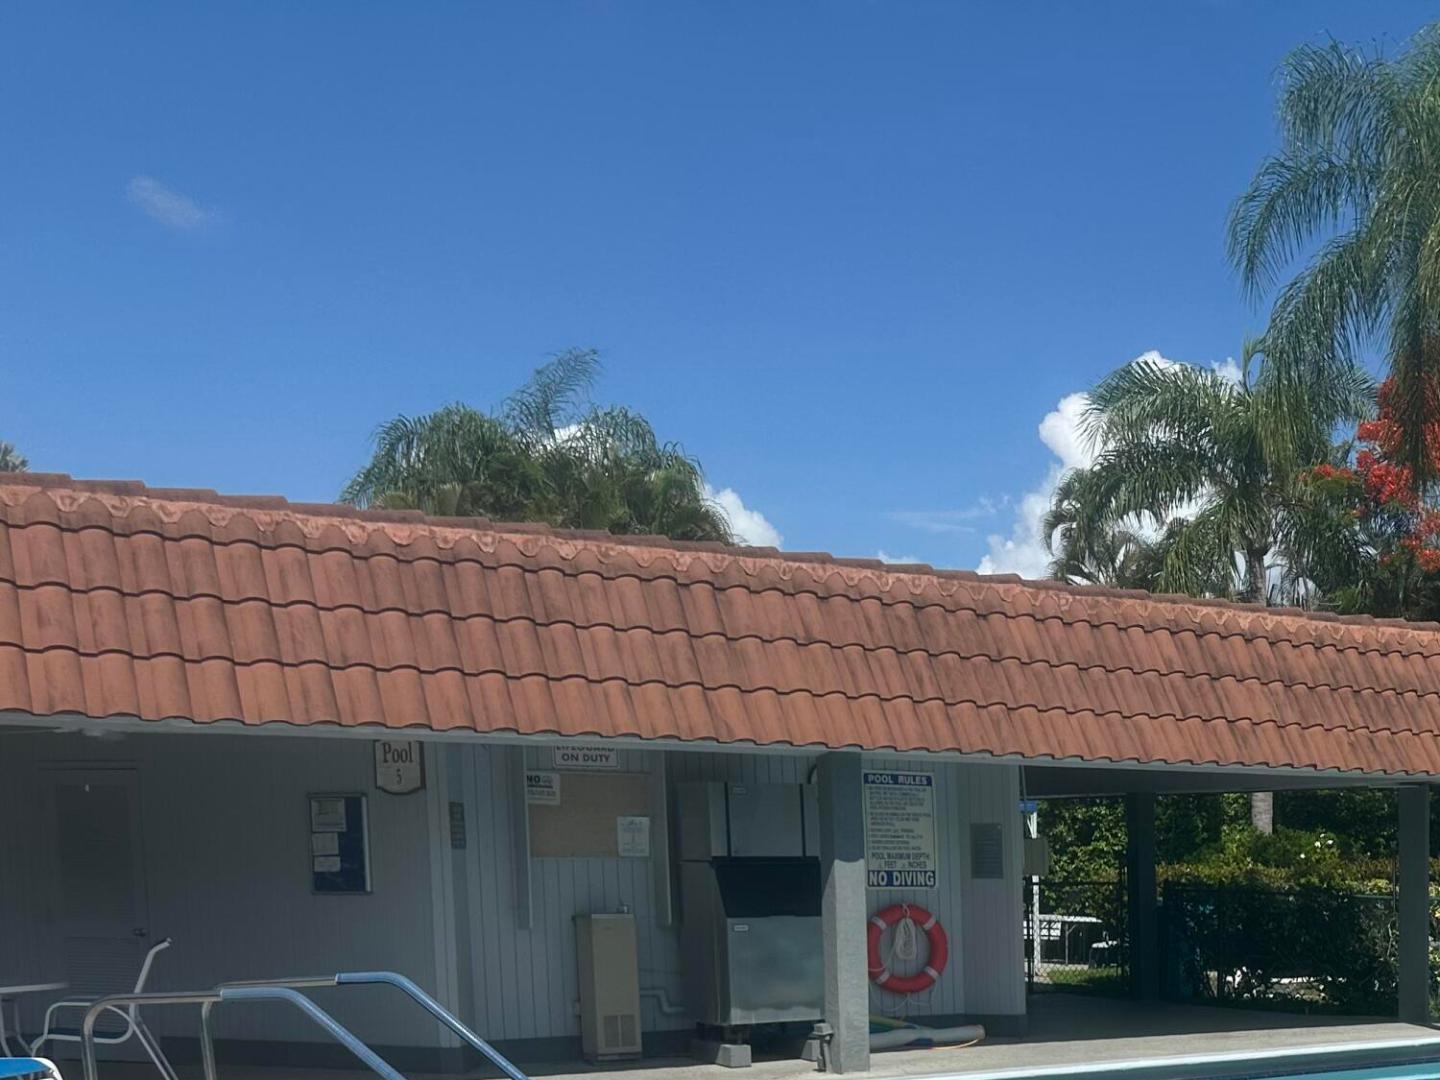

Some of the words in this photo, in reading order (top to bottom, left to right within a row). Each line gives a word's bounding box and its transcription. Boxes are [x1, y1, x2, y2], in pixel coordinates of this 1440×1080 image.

[382, 741, 413, 763] Pool
[561, 753, 579, 762] ON
[583, 754, 611, 763] DUTY
[868, 774, 894, 784] POOL
[898, 775, 927, 785] RULES
[869, 871, 887, 886] NO
[892, 871, 935, 886] DIVING
